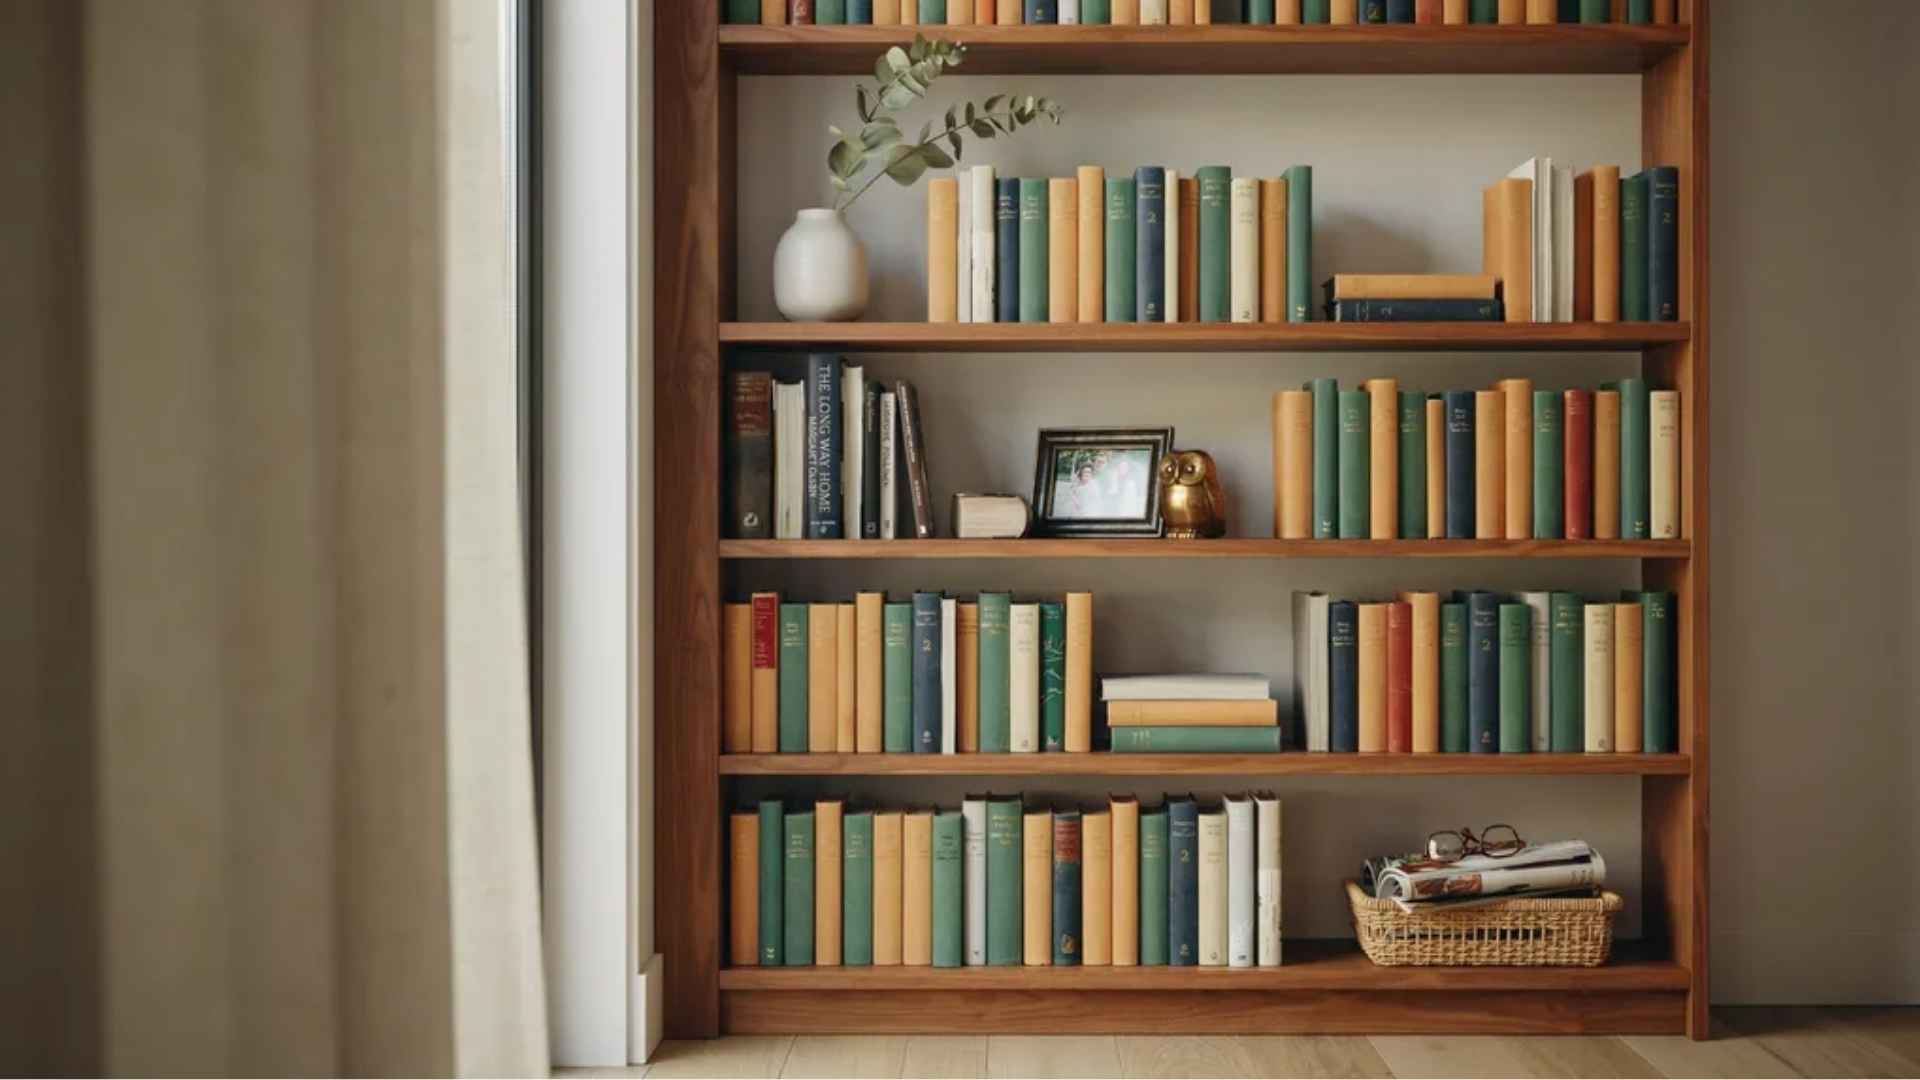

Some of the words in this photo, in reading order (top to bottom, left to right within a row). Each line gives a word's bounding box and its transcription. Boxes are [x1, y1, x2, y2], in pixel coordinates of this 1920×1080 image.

[818, 364, 831, 392] THE
[818, 395, 831, 435] LONG
[818, 437, 831, 468] WAY
[818, 472, 831, 513] HOME
